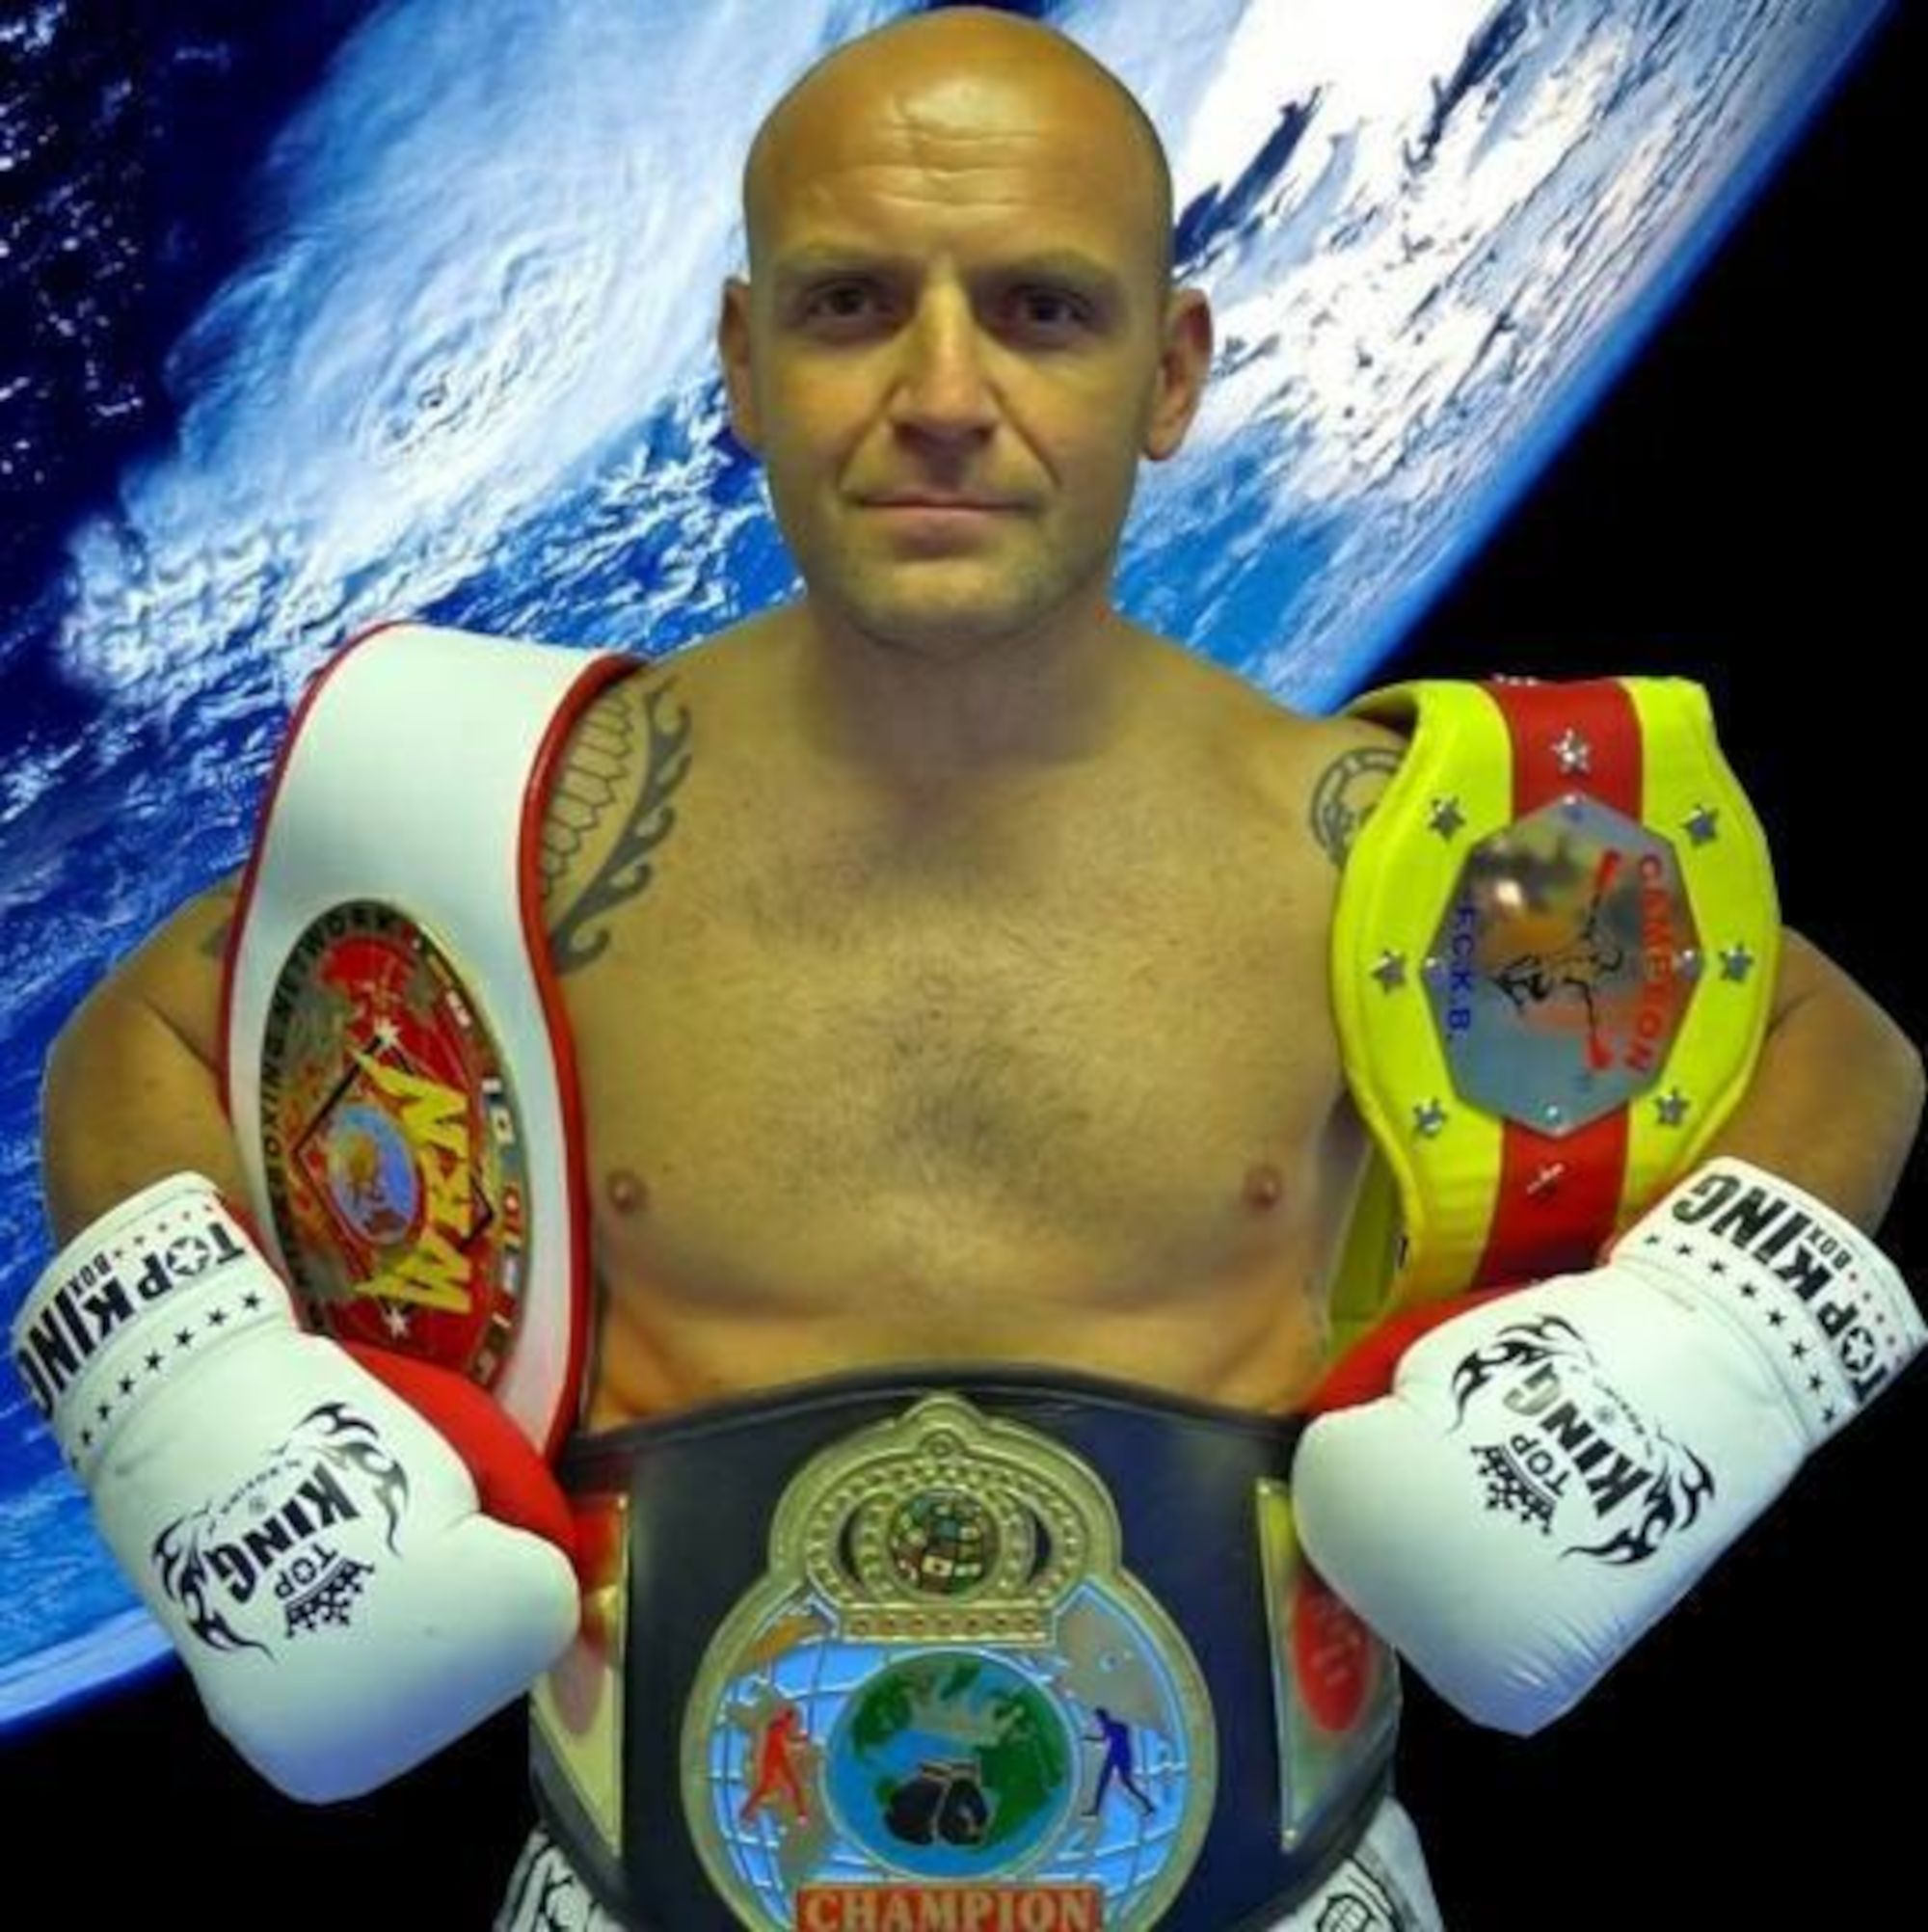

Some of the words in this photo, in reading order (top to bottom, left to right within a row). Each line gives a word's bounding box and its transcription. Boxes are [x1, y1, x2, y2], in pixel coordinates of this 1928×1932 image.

[138, 1221, 246, 1300] TOP
[1672, 1172, 1834, 1303] KING
[1816, 1300, 1890, 1407] TOP
[1501, 1362, 1655, 1518] KING
[1509, 1432, 1573, 1498] TOP
[203, 1461, 362, 1605] KING
[273, 1543, 339, 1599] TOP
[804, 1888, 1095, 1931] CHAMPION
